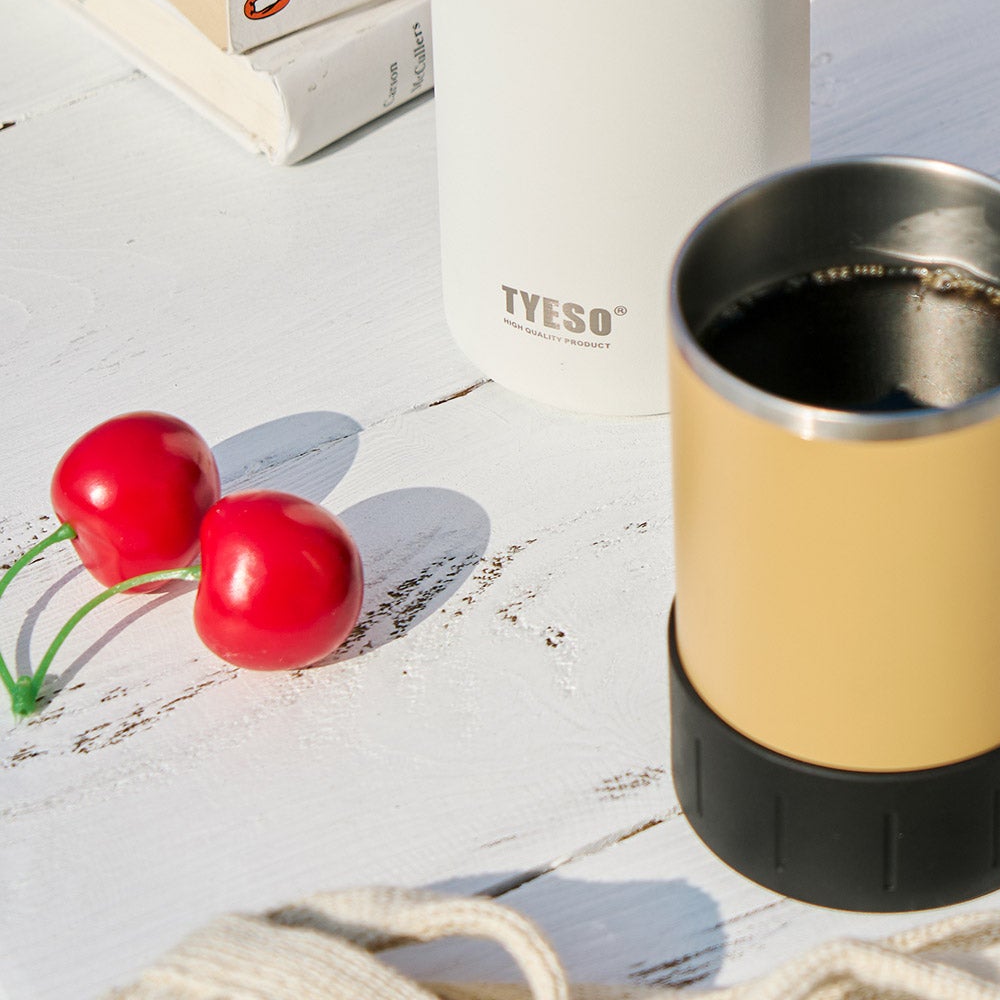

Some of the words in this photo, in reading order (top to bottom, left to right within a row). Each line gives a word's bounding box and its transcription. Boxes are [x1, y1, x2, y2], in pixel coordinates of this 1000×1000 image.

[383, 61, 398, 107] Carson
[503, 317, 524, 331] HIGH
[525, 326, 562, 343] QUALITY
[564, 337, 612, 350] PRODUCT
